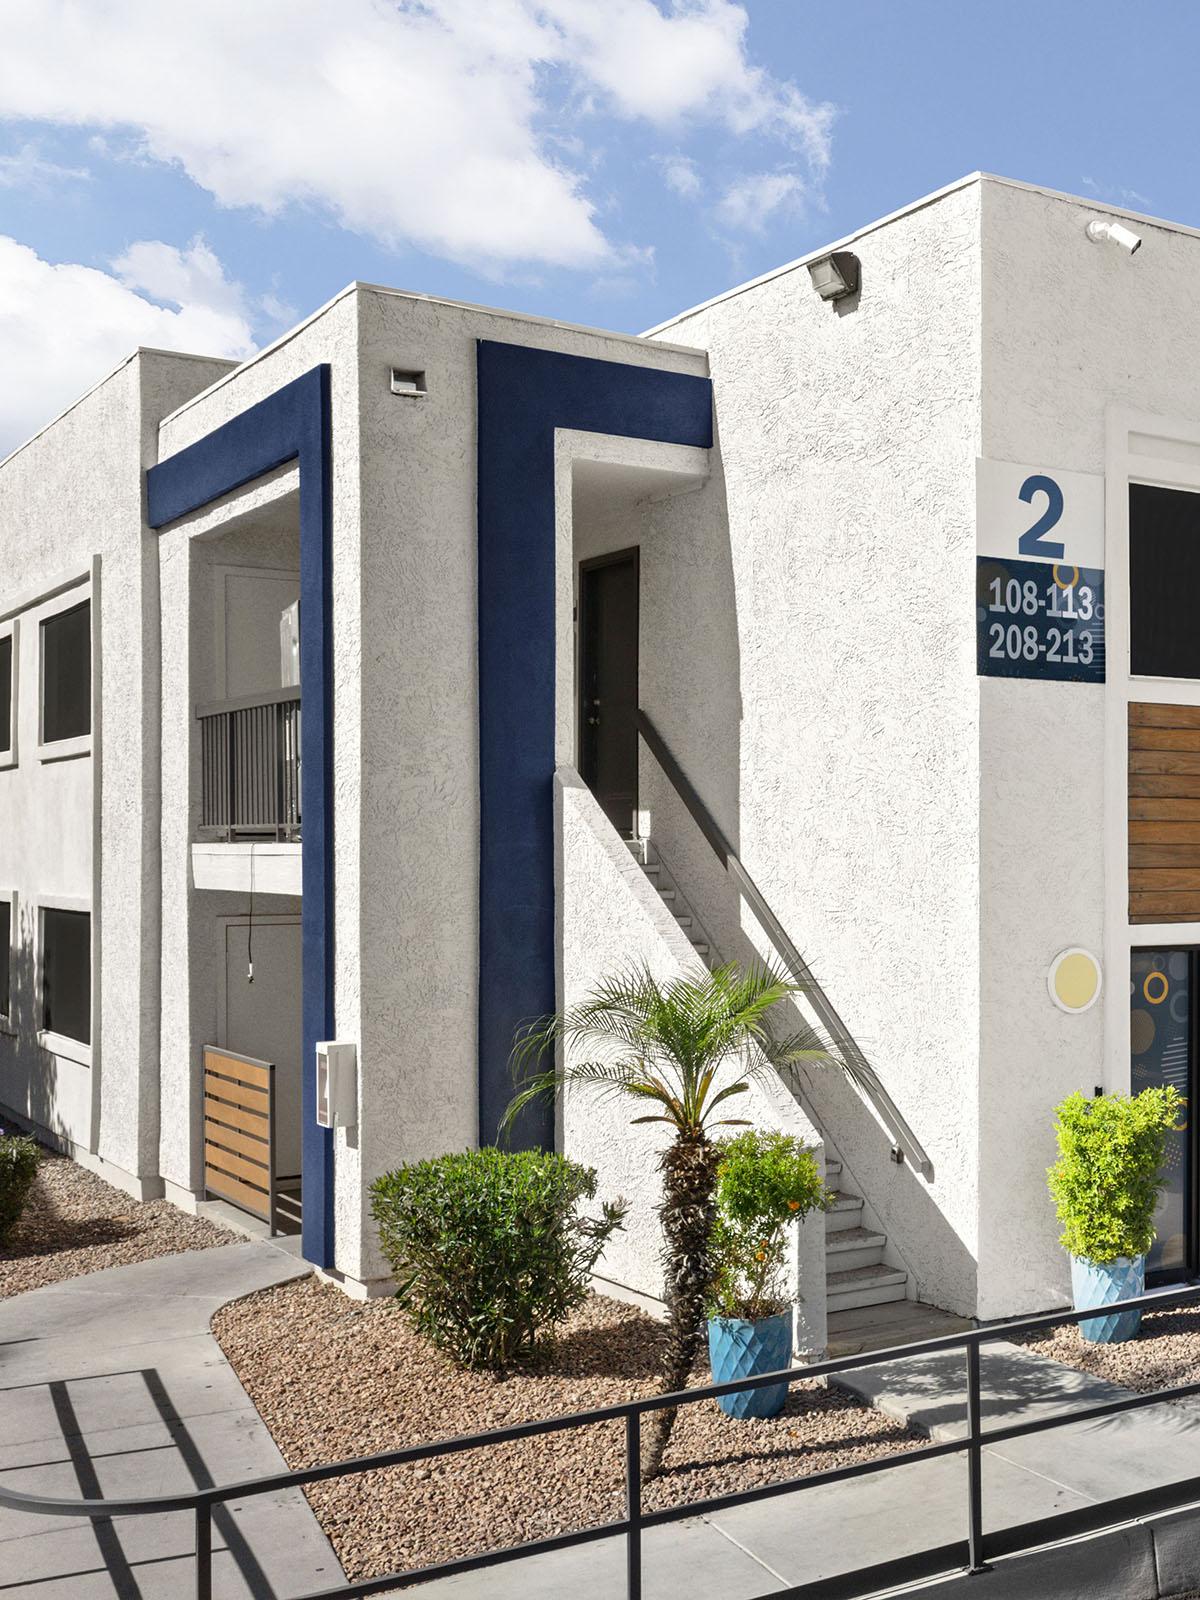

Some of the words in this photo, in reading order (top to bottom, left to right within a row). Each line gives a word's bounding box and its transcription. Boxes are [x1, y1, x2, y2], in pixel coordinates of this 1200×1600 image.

[1018, 475, 1065, 559] 2
[989, 577, 1093, 621] 108-113
[989, 623, 1094, 665] 208-213
